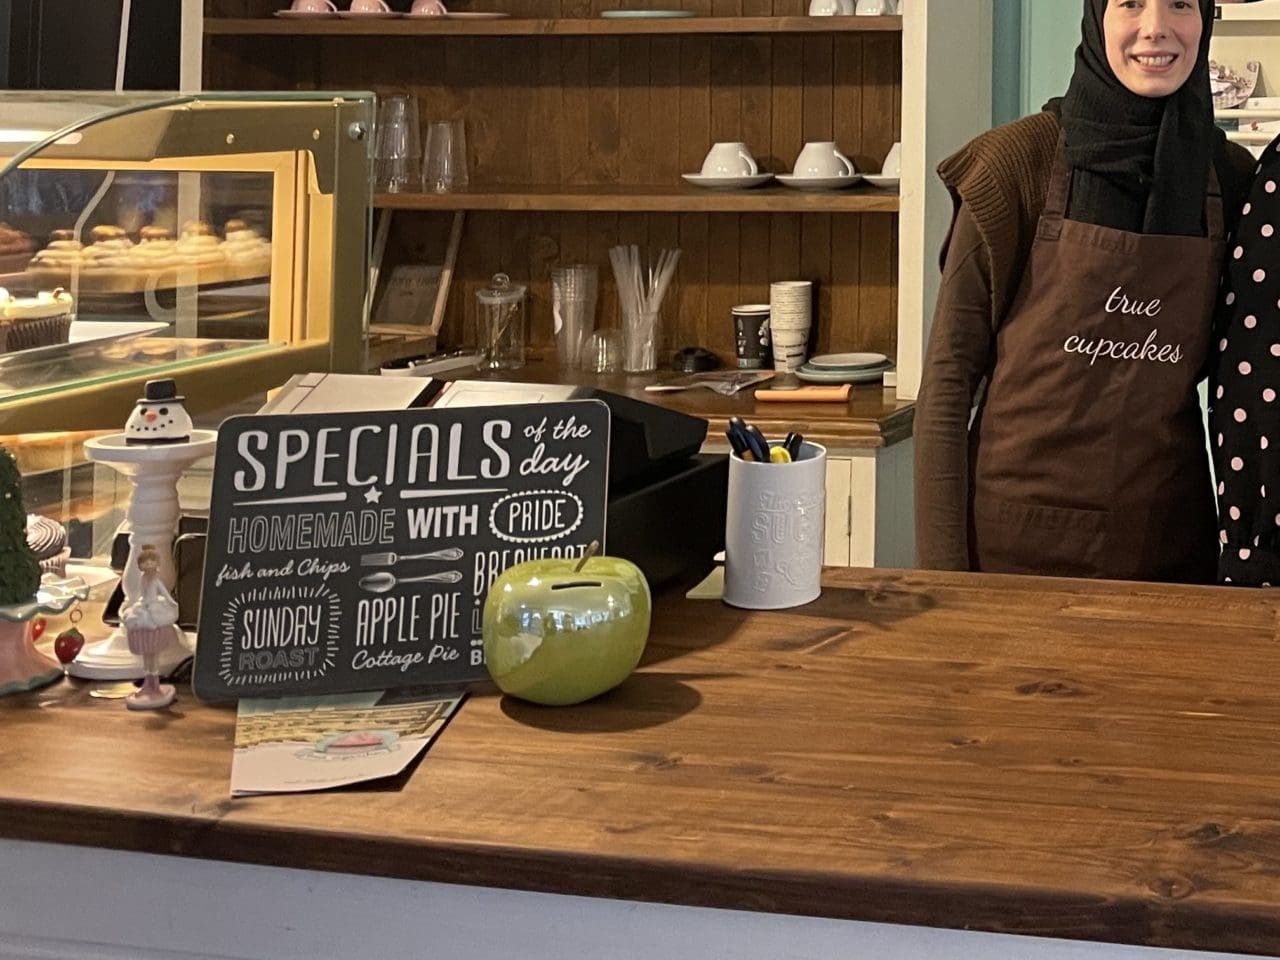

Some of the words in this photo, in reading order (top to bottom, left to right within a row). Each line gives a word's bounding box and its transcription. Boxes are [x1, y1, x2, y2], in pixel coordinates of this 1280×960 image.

[1105, 286, 1161, 317] true
[1064, 329, 1183, 366] cupcakes
[233, 419, 512, 493] SPECIALS
[523, 419, 545, 443] of
[552, 416, 592, 440] the
[519, 443, 590, 487] day
[227, 509, 396, 554] HOMEMADE
[407, 505, 479, 539] WITH
[508, 499, 566, 533] PRIDE
[215, 561, 254, 587] fish
[256, 559, 293, 579] and
[297, 558, 351, 582] Chips
[241, 604, 322, 650] SUNDAY
[356, 598, 421, 647] APPLE
[430, 593, 461, 641] PIE
[239, 647, 319, 671] ROAST
[352, 649, 423, 673] Cottage
[428, 645, 459, 662] Pie
